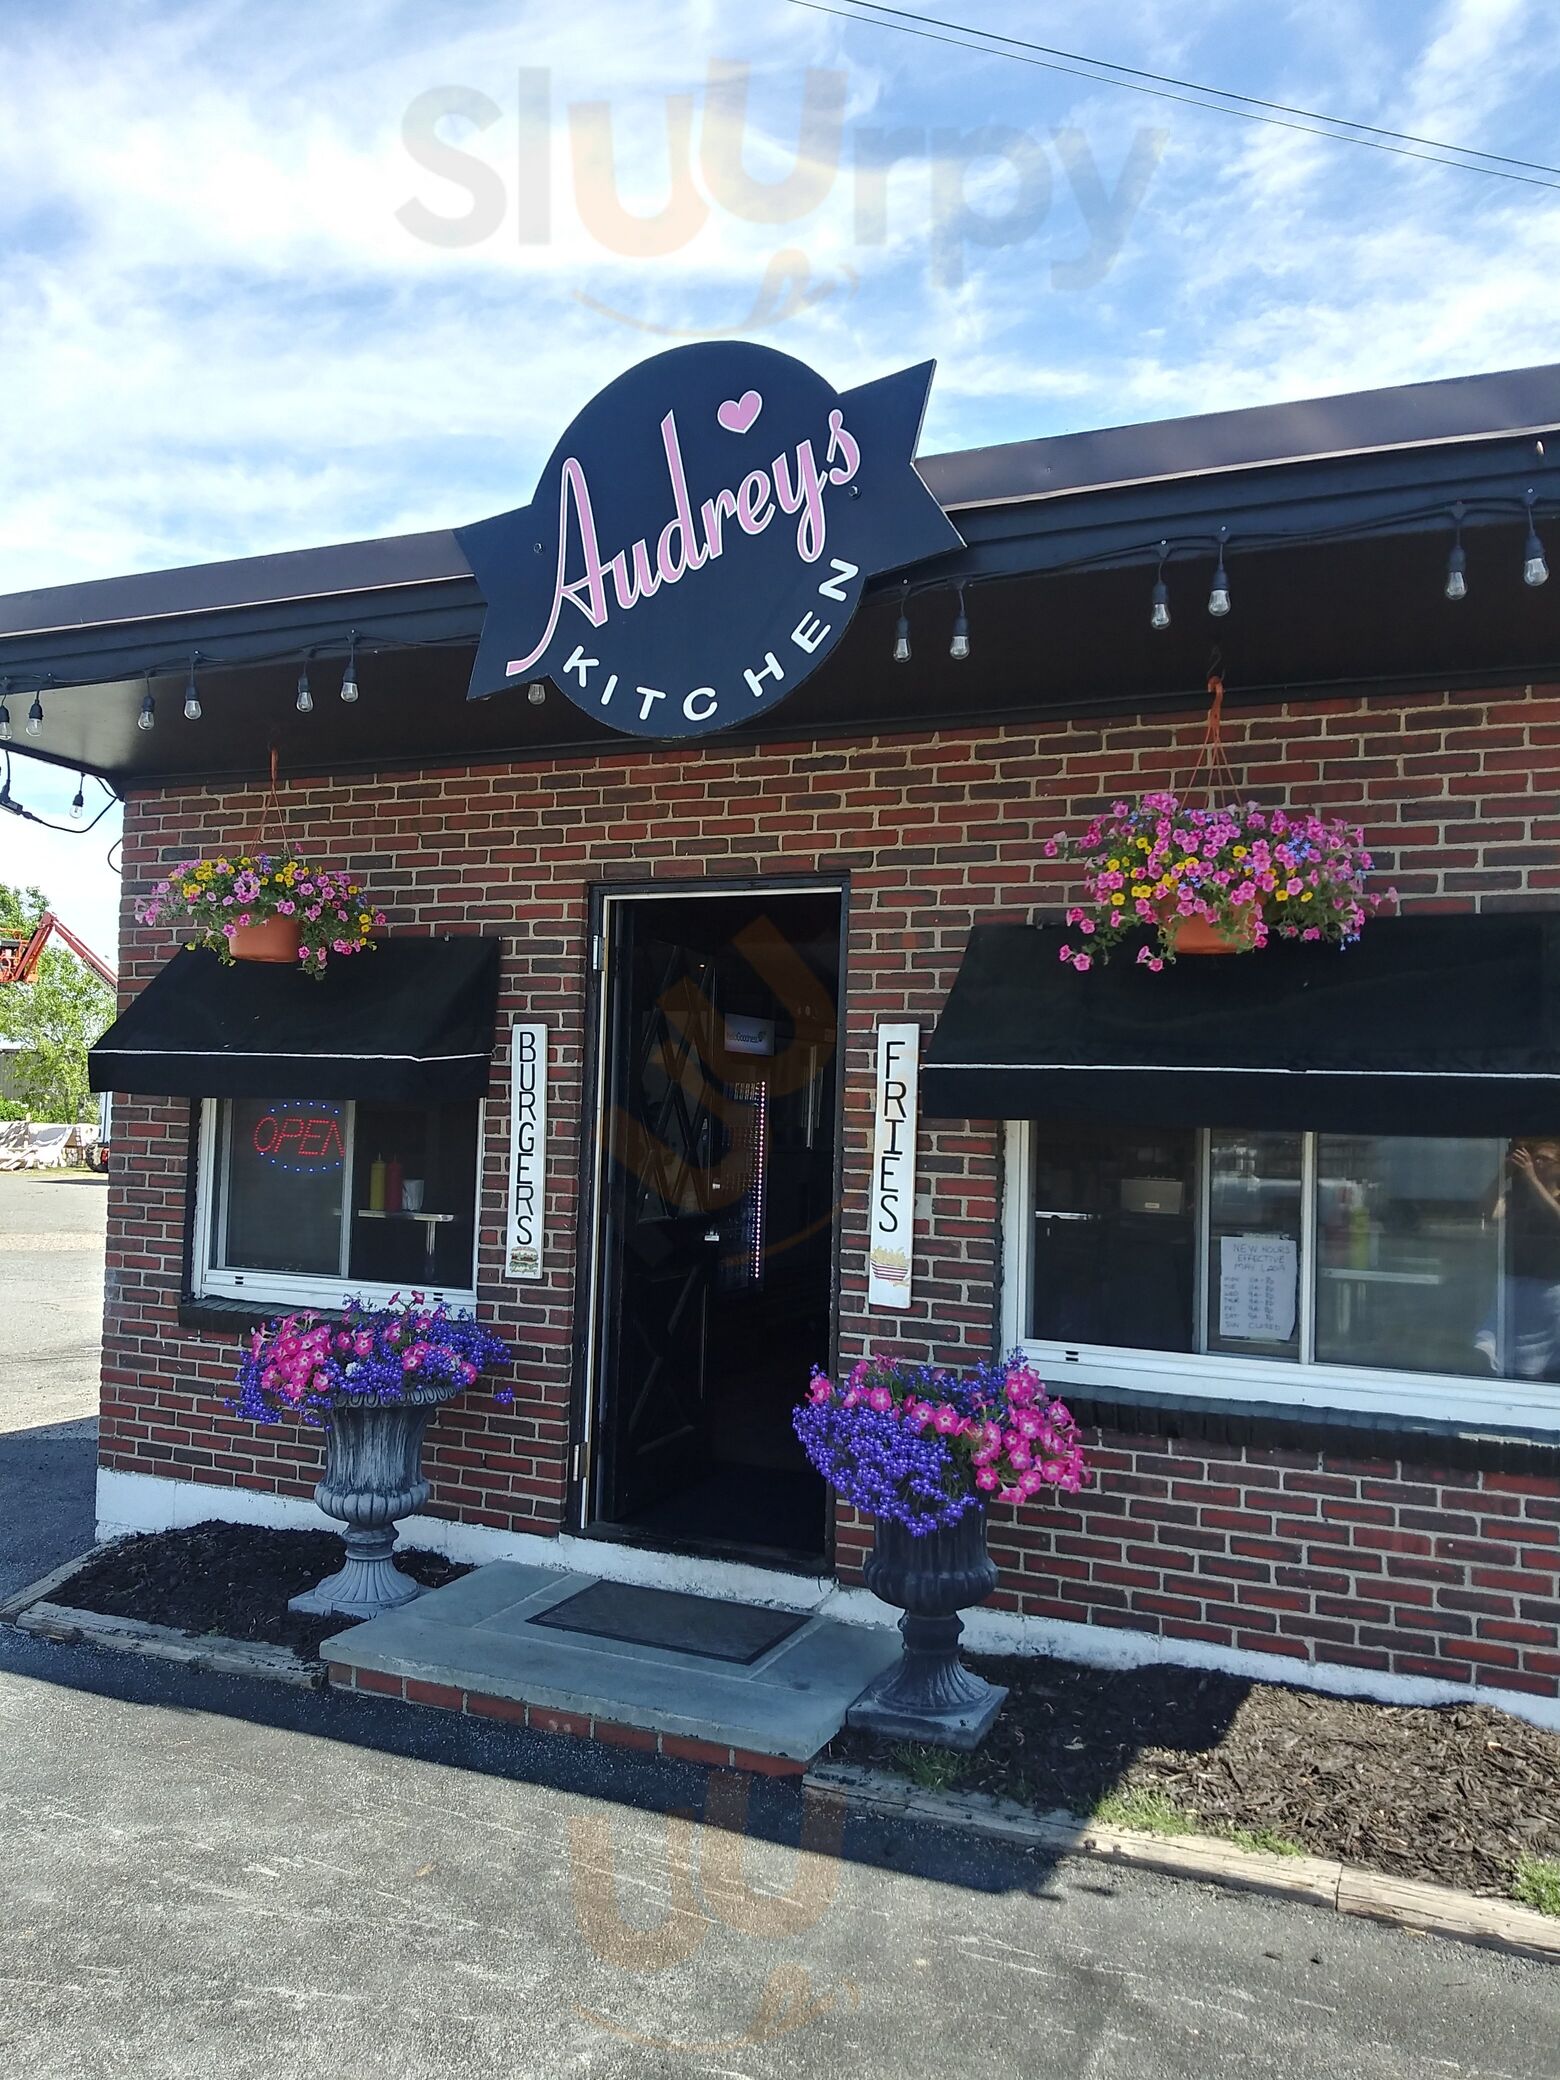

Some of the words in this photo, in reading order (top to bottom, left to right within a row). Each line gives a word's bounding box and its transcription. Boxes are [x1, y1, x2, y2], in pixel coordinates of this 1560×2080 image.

[505, 409, 861, 677] Audreys
[563, 558, 859, 721] KITCHEN
[253, 1116, 345, 1157] OPEN
[515, 1031, 537, 1245] BURGERS
[878, 1041, 907, 1233] FRIES
[1233, 1243, 1257, 1253] NEW
